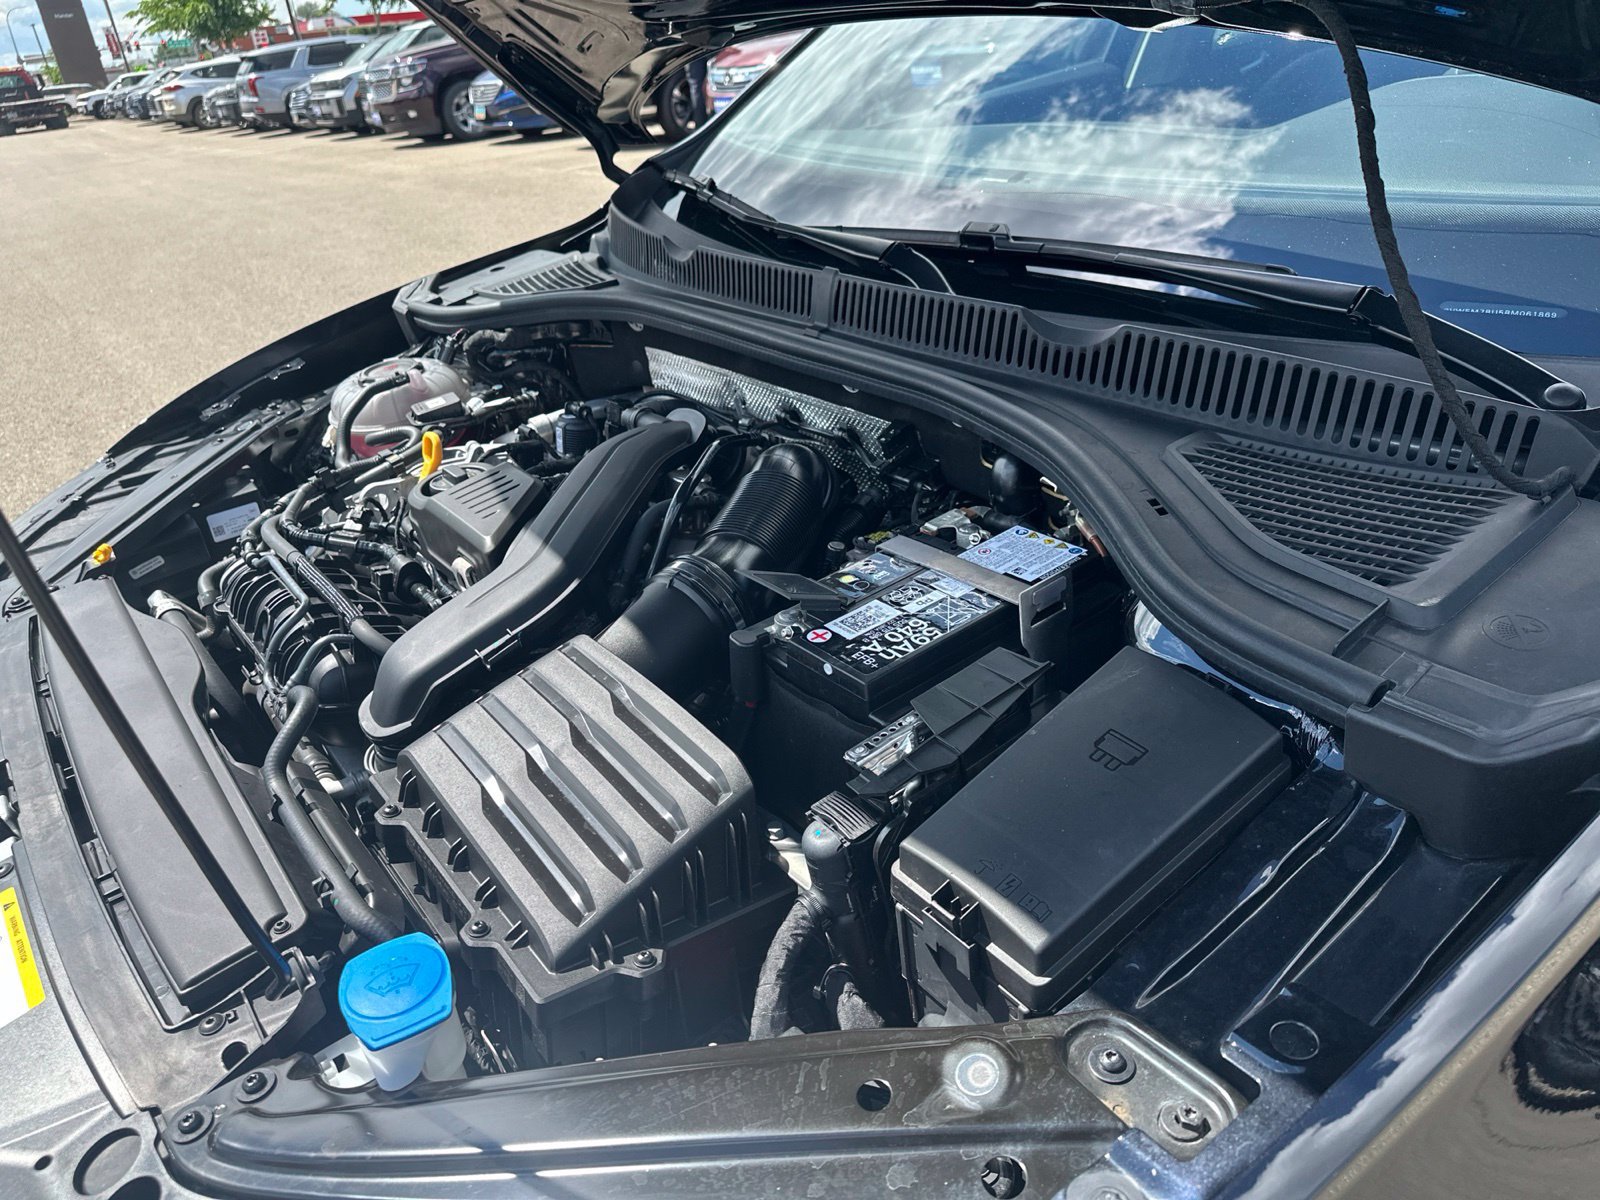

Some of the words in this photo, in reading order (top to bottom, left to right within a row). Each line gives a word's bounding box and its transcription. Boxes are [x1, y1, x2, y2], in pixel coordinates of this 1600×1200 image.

[878, 626, 944, 660] 59Ah
[884, 618, 929, 643] 640
[850, 650, 879, 669] EFB+
